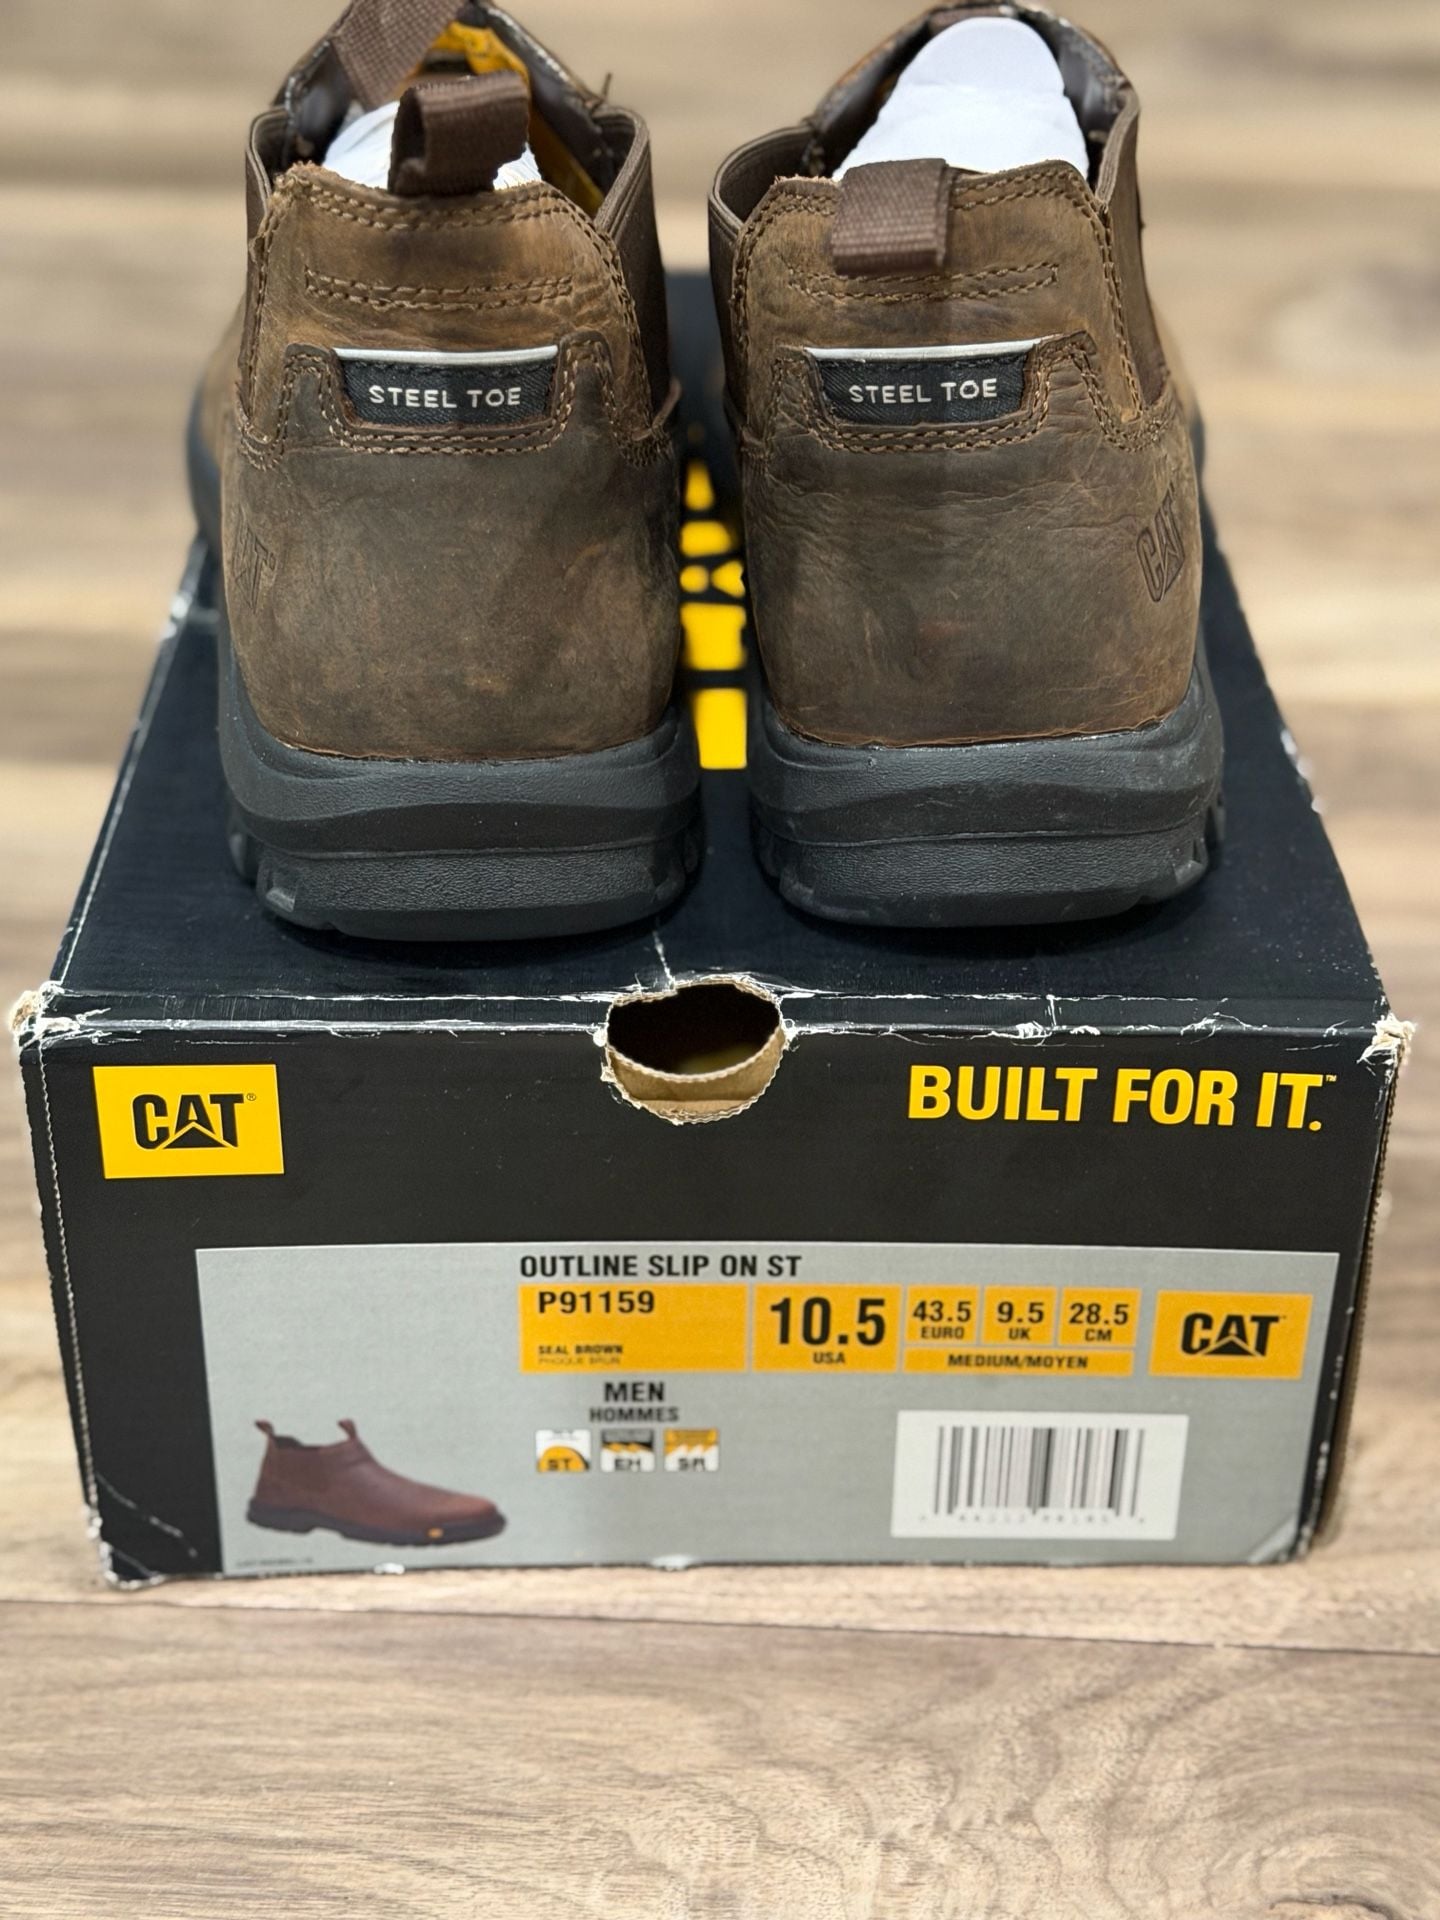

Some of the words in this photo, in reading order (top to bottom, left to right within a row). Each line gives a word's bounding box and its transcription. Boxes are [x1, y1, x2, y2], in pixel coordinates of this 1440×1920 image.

[368, 384, 457, 408] STEEL
[467, 386, 522, 408] TOE
[848, 384, 931, 403] STEEL
[941, 378, 998, 401] TOE
[907, 1065, 1098, 1121] BUILT
[1112, 1068, 1239, 1126] FOR
[132, 1093, 245, 1150] CAT
[519, 1255, 638, 1277] OUTLINE
[647, 1255, 710, 1277] SLIP
[720, 1255, 758, 1277] ON
[767, 1255, 802, 1277] ST
[538, 1291, 656, 1314] P91159
[912, 1300, 972, 1322] 43.5
[997, 1301, 1044, 1323] 9.5
[770, 1297, 886, 1346] 10.5
[1069, 1303, 1129, 1325] 28.5
[920, 1326, 965, 1339] EURO
[1008, 1328, 1031, 1341] UK
[1085, 1329, 1112, 1342] CM
[1180, 1312, 1280, 1357] CAT
[575, 1345, 624, 1355] BROWN
[813, 1352, 846, 1364] USA
[948, 1354, 1088, 1369] MEDIUM/MOYEN
[604, 1382, 665, 1402] MEN
[589, 1407, 679, 1423] HOMMES
